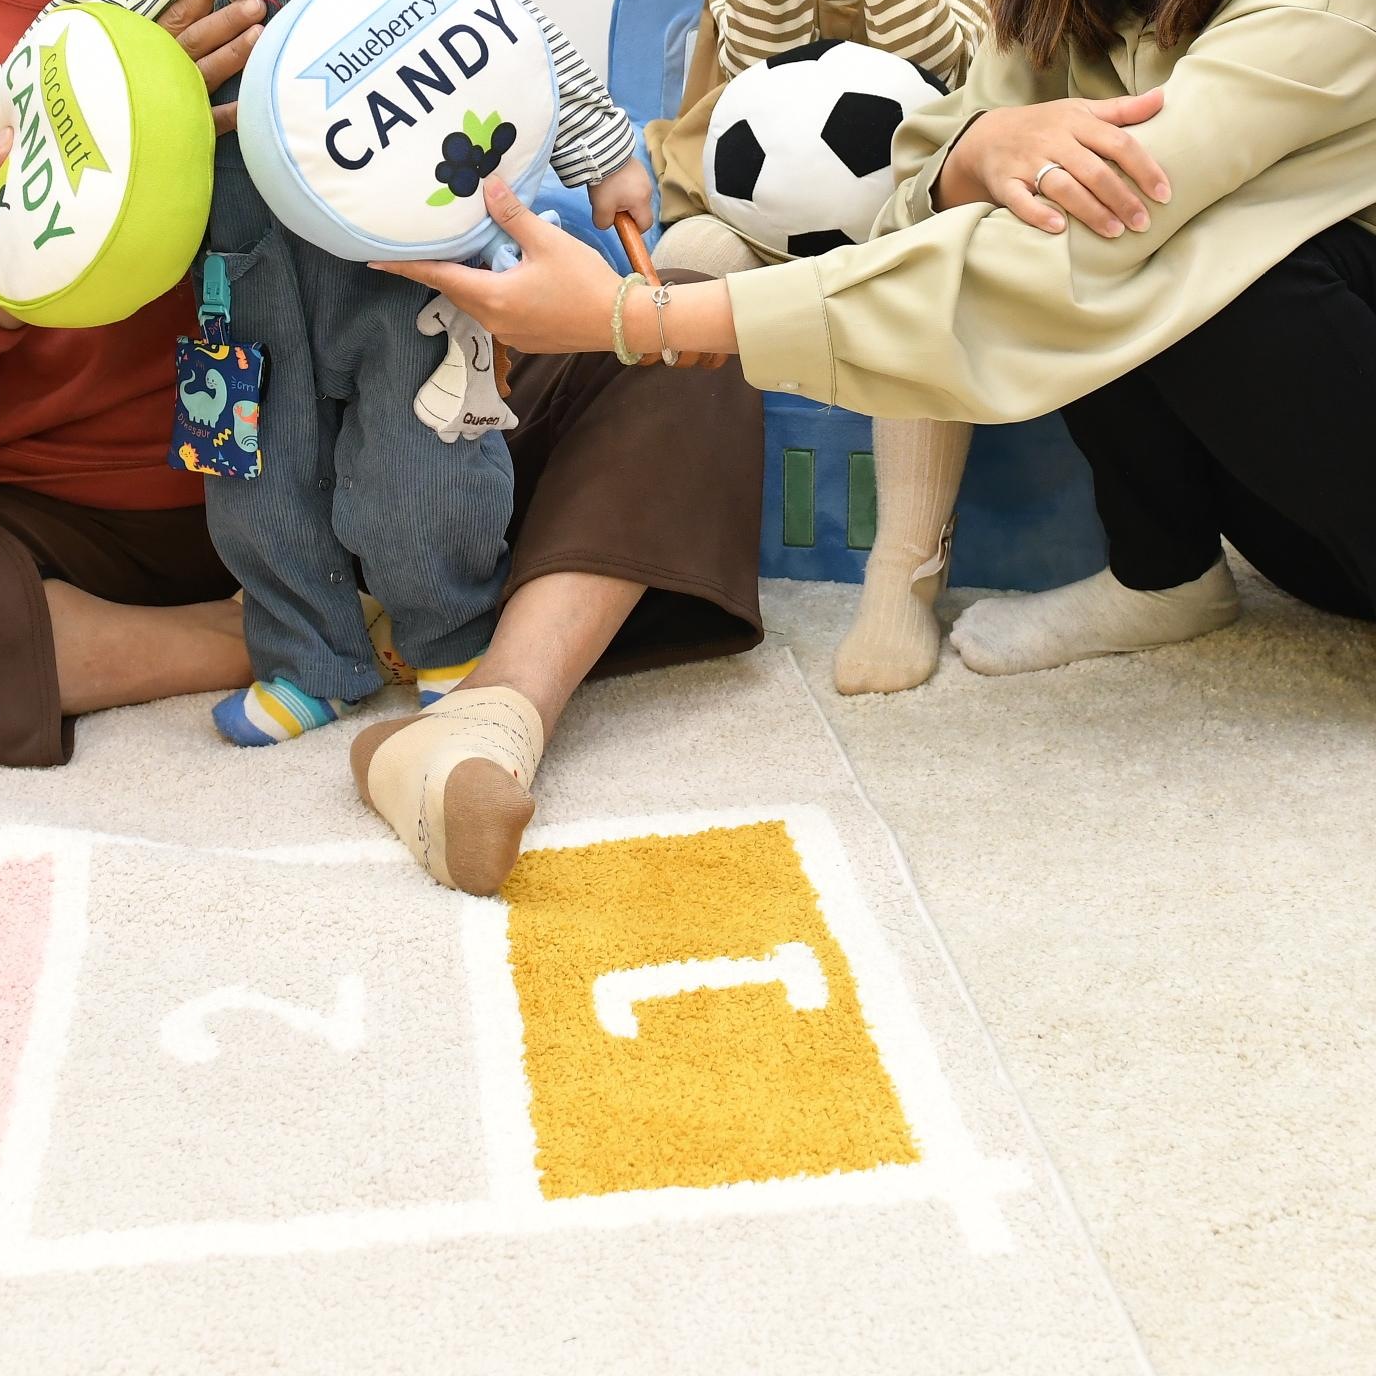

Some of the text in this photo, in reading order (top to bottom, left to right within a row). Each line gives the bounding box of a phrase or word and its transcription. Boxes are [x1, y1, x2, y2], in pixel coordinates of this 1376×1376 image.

[6, 45, 75, 250] CANDY
[42, 52, 92, 172] coconut
[462, 412, 500, 426] Queen
[159, 974, 366, 1064] 2
[592, 941, 828, 1040] 1
